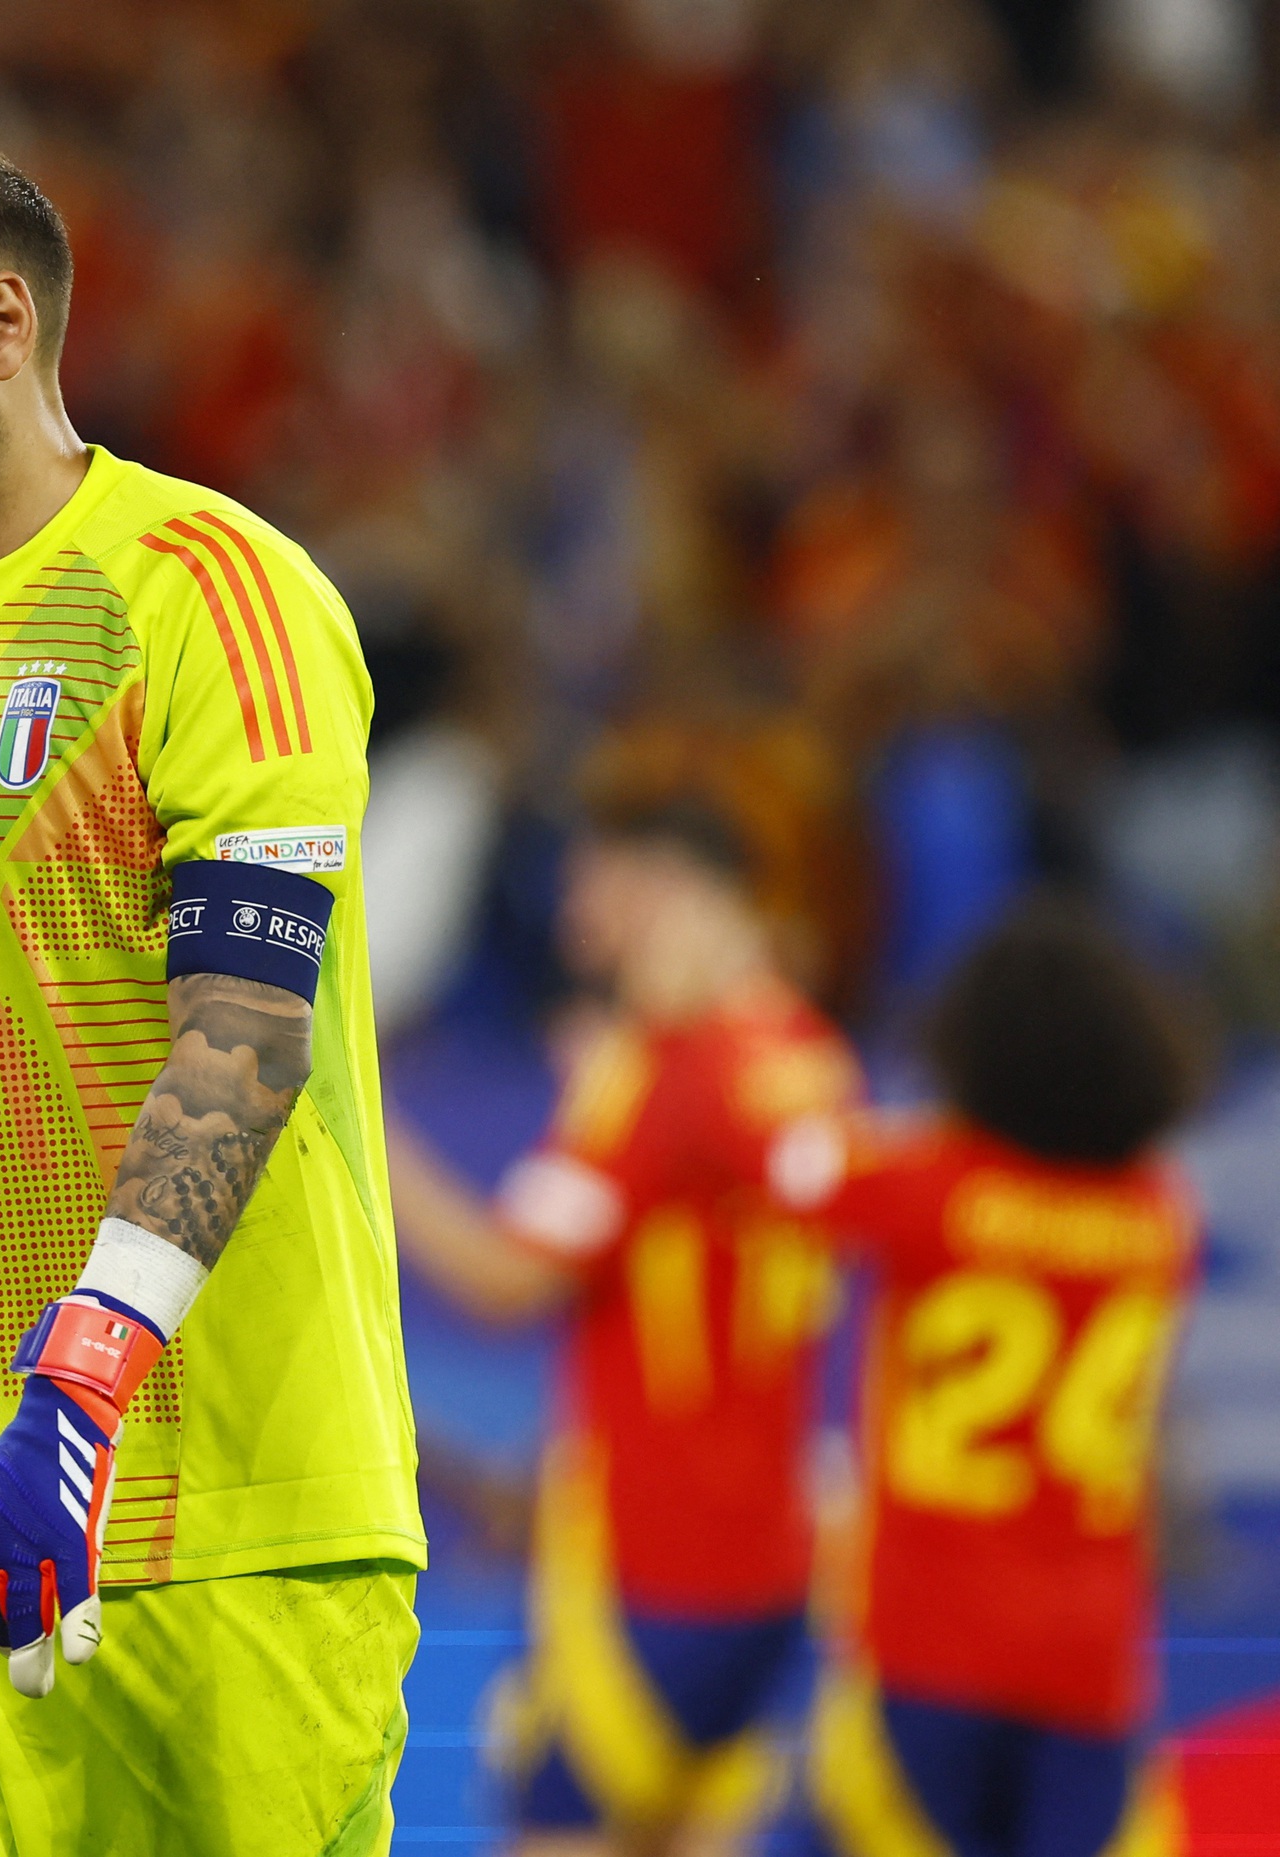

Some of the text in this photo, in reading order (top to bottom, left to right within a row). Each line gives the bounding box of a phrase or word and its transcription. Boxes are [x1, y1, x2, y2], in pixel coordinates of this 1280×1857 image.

[9, 687, 52, 708] ITALIA
[219, 835, 249, 847] UEFA
[220, 840, 343, 861] FOUNDATION
[313, 860, 322, 871] for
[884, 1270, 1166, 1540] 24
